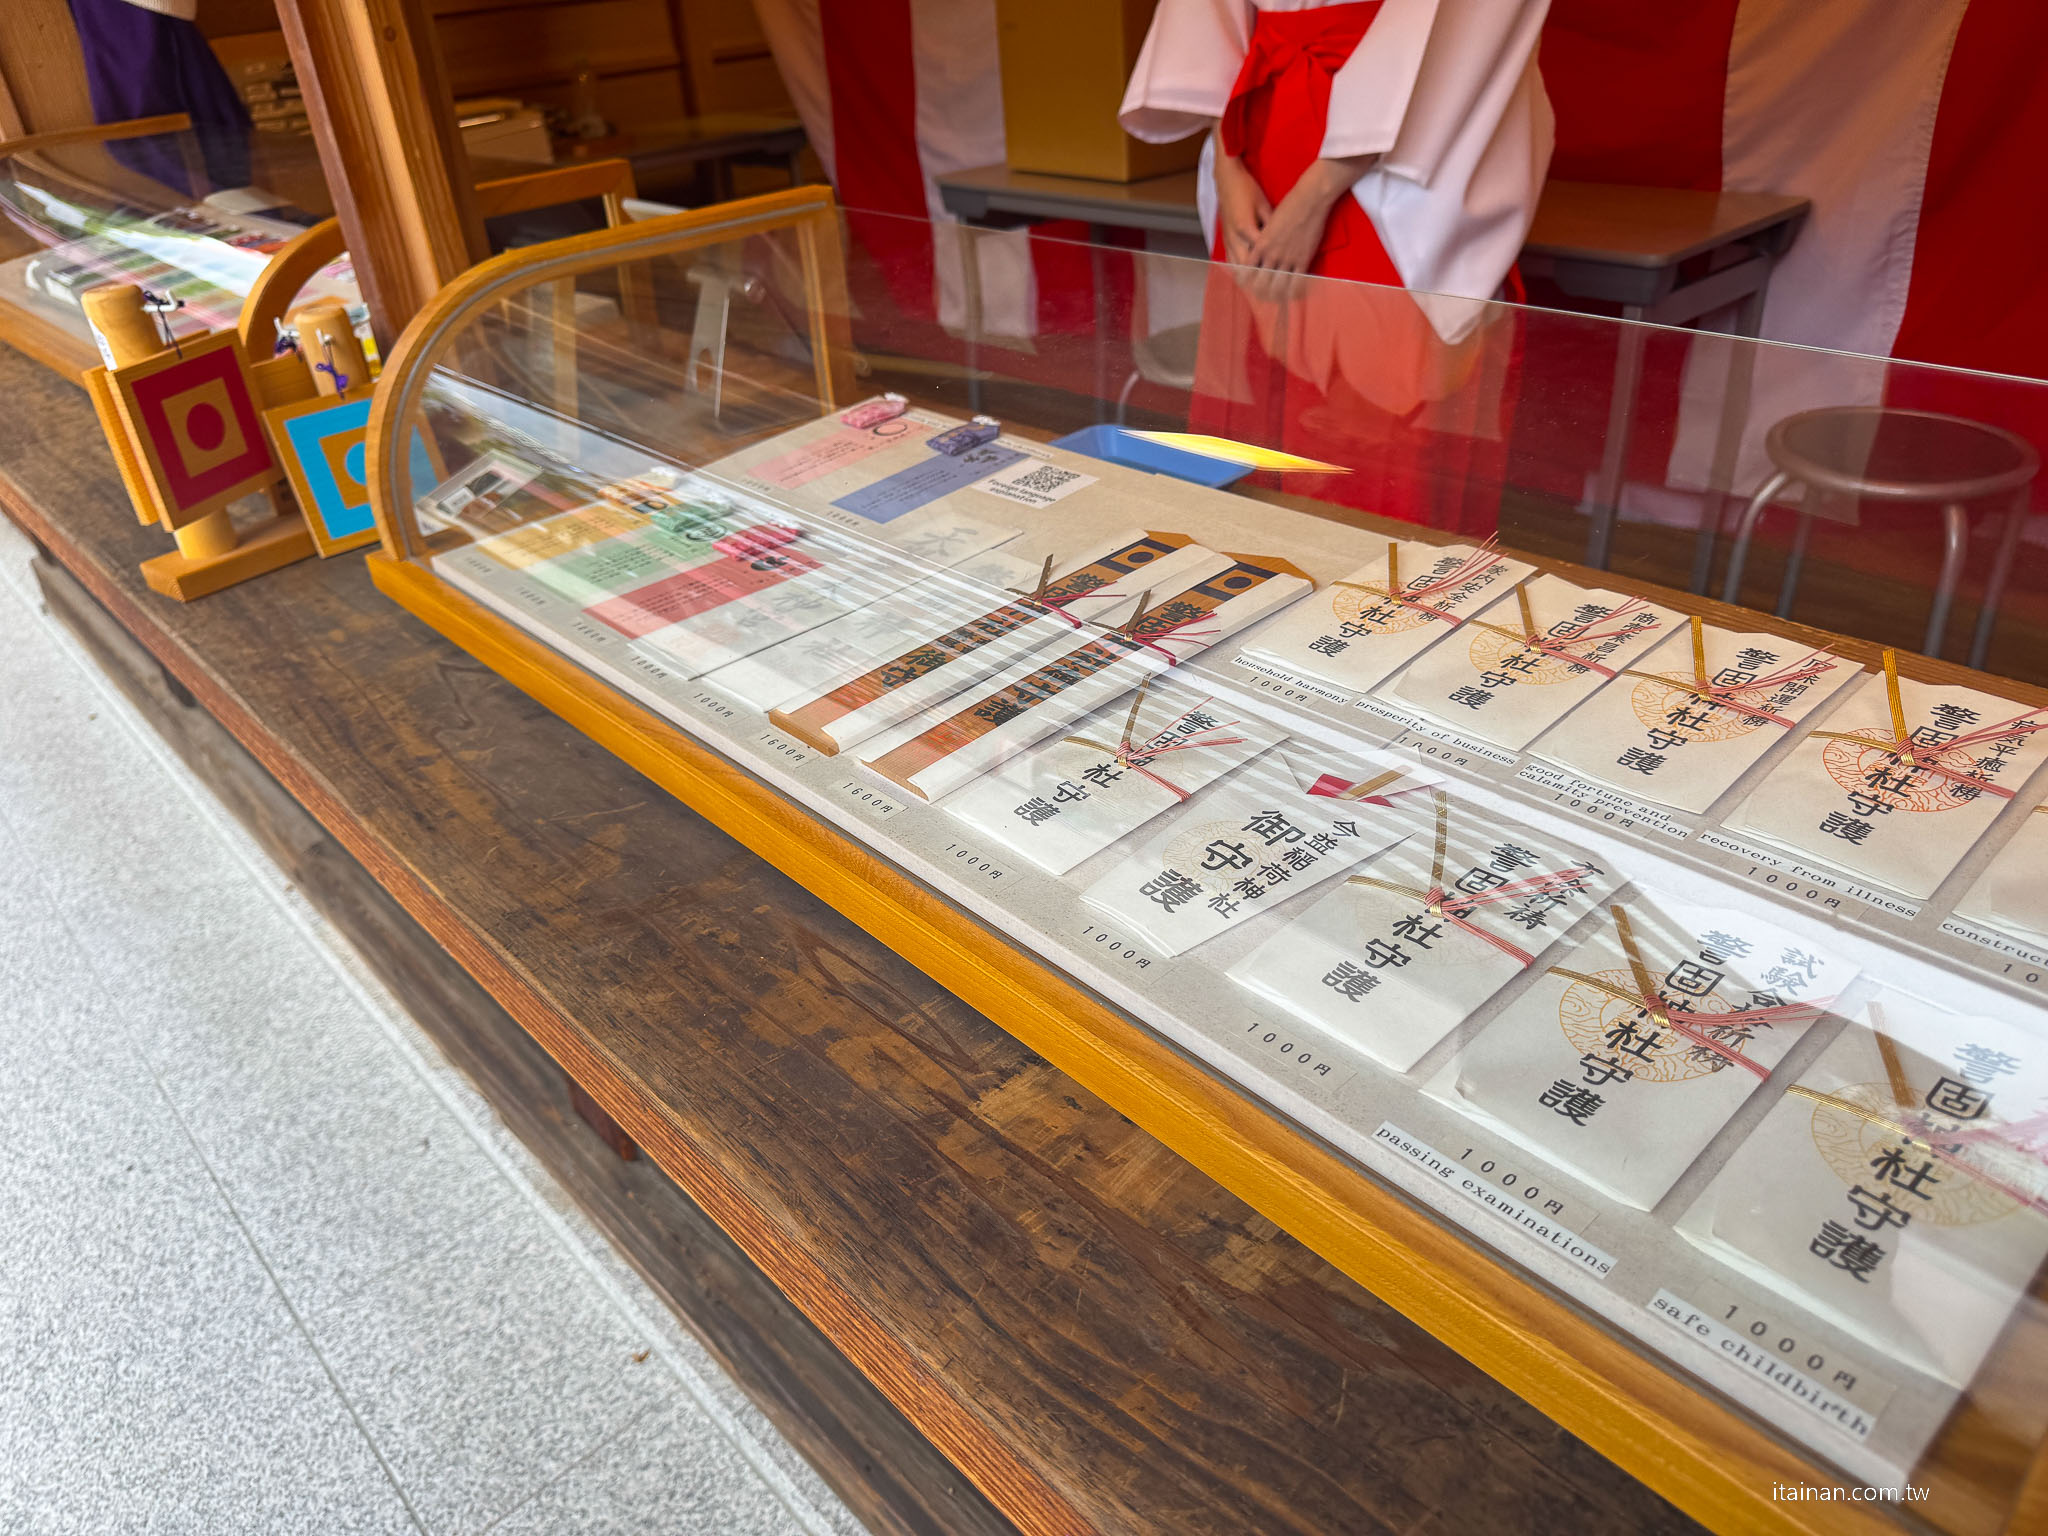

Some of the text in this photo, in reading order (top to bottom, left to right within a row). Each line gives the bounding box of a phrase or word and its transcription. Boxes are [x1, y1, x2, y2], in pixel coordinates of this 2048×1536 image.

[1234, 656, 1348, 703] household harmony
[1250, 676, 1307, 702] 1000円
[760, 734, 806, 761] 1600円
[1355, 700, 1516, 765] prosperity of business
[843, 782, 893, 813] 1600円
[1519, 771, 1688, 838] calamity prevention
[1524, 764, 1672, 822] good fortune and
[1554, 794, 1634, 828] 1000円
[946, 843, 1003, 879] 1000円
[1138, 810, 1307, 913] 御守護
[1700, 832, 1916, 918] recovery from illness
[1748, 866, 1840, 909] 1000円
[1082, 926, 1151, 968] 1000円
[1247, 1022, 1331, 1076] 1000円
[1376, 1126, 1611, 1275] passing examinations
[1460, 1148, 1564, 1216] 1000円
[1653, 1297, 1868, 1437] safe childbirth
[1724, 1304, 1857, 1391] 1000円
